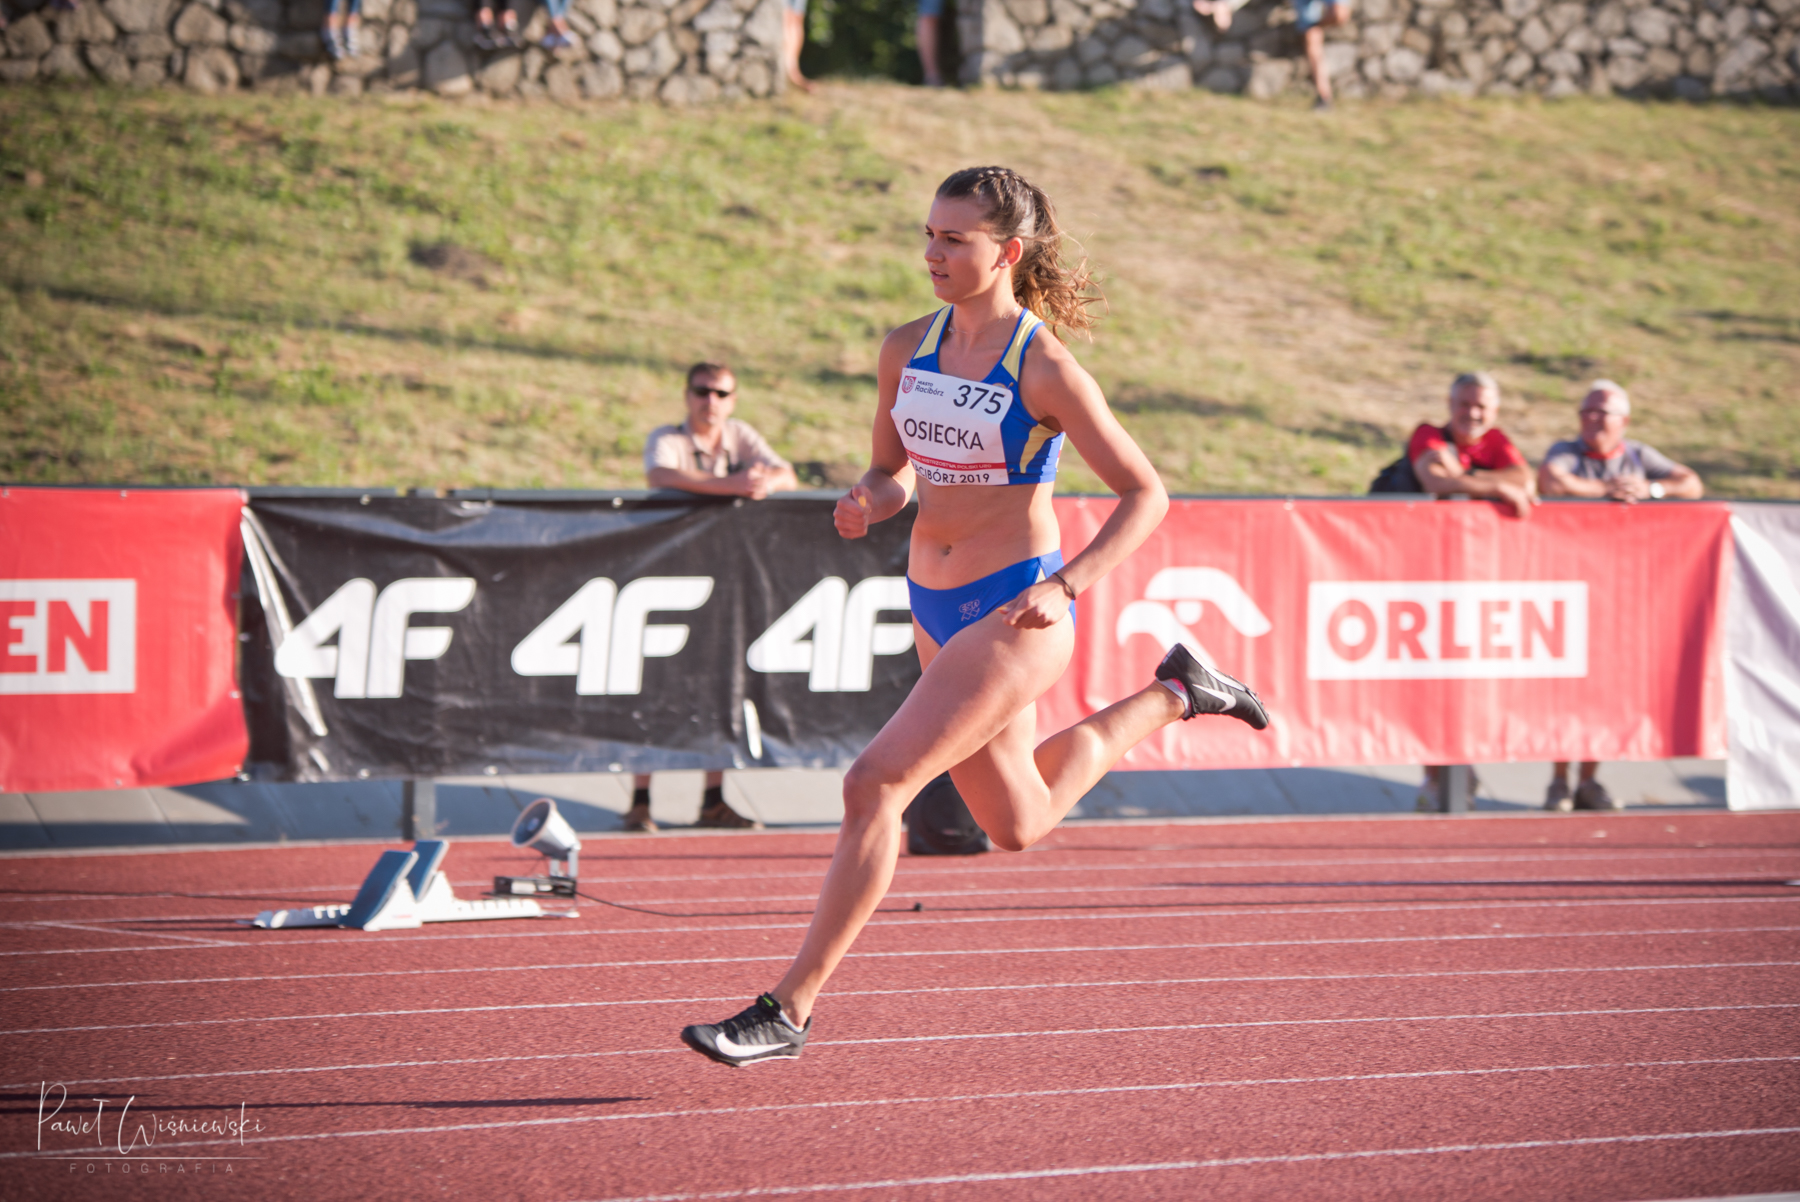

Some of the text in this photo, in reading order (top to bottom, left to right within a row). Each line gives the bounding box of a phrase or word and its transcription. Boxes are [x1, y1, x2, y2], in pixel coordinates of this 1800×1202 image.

[914, 384, 944, 396] Racibórz
[953, 384, 1005, 415] 375
[903, 418, 984, 451] OSIECKA
[922, 457, 957, 469] MISTRZOSTWA
[959, 473, 990, 484] 2019
[275, 577, 476, 699] 4F
[511, 576, 715, 695] 4F
[1326, 599, 1566, 661] ORLEN
